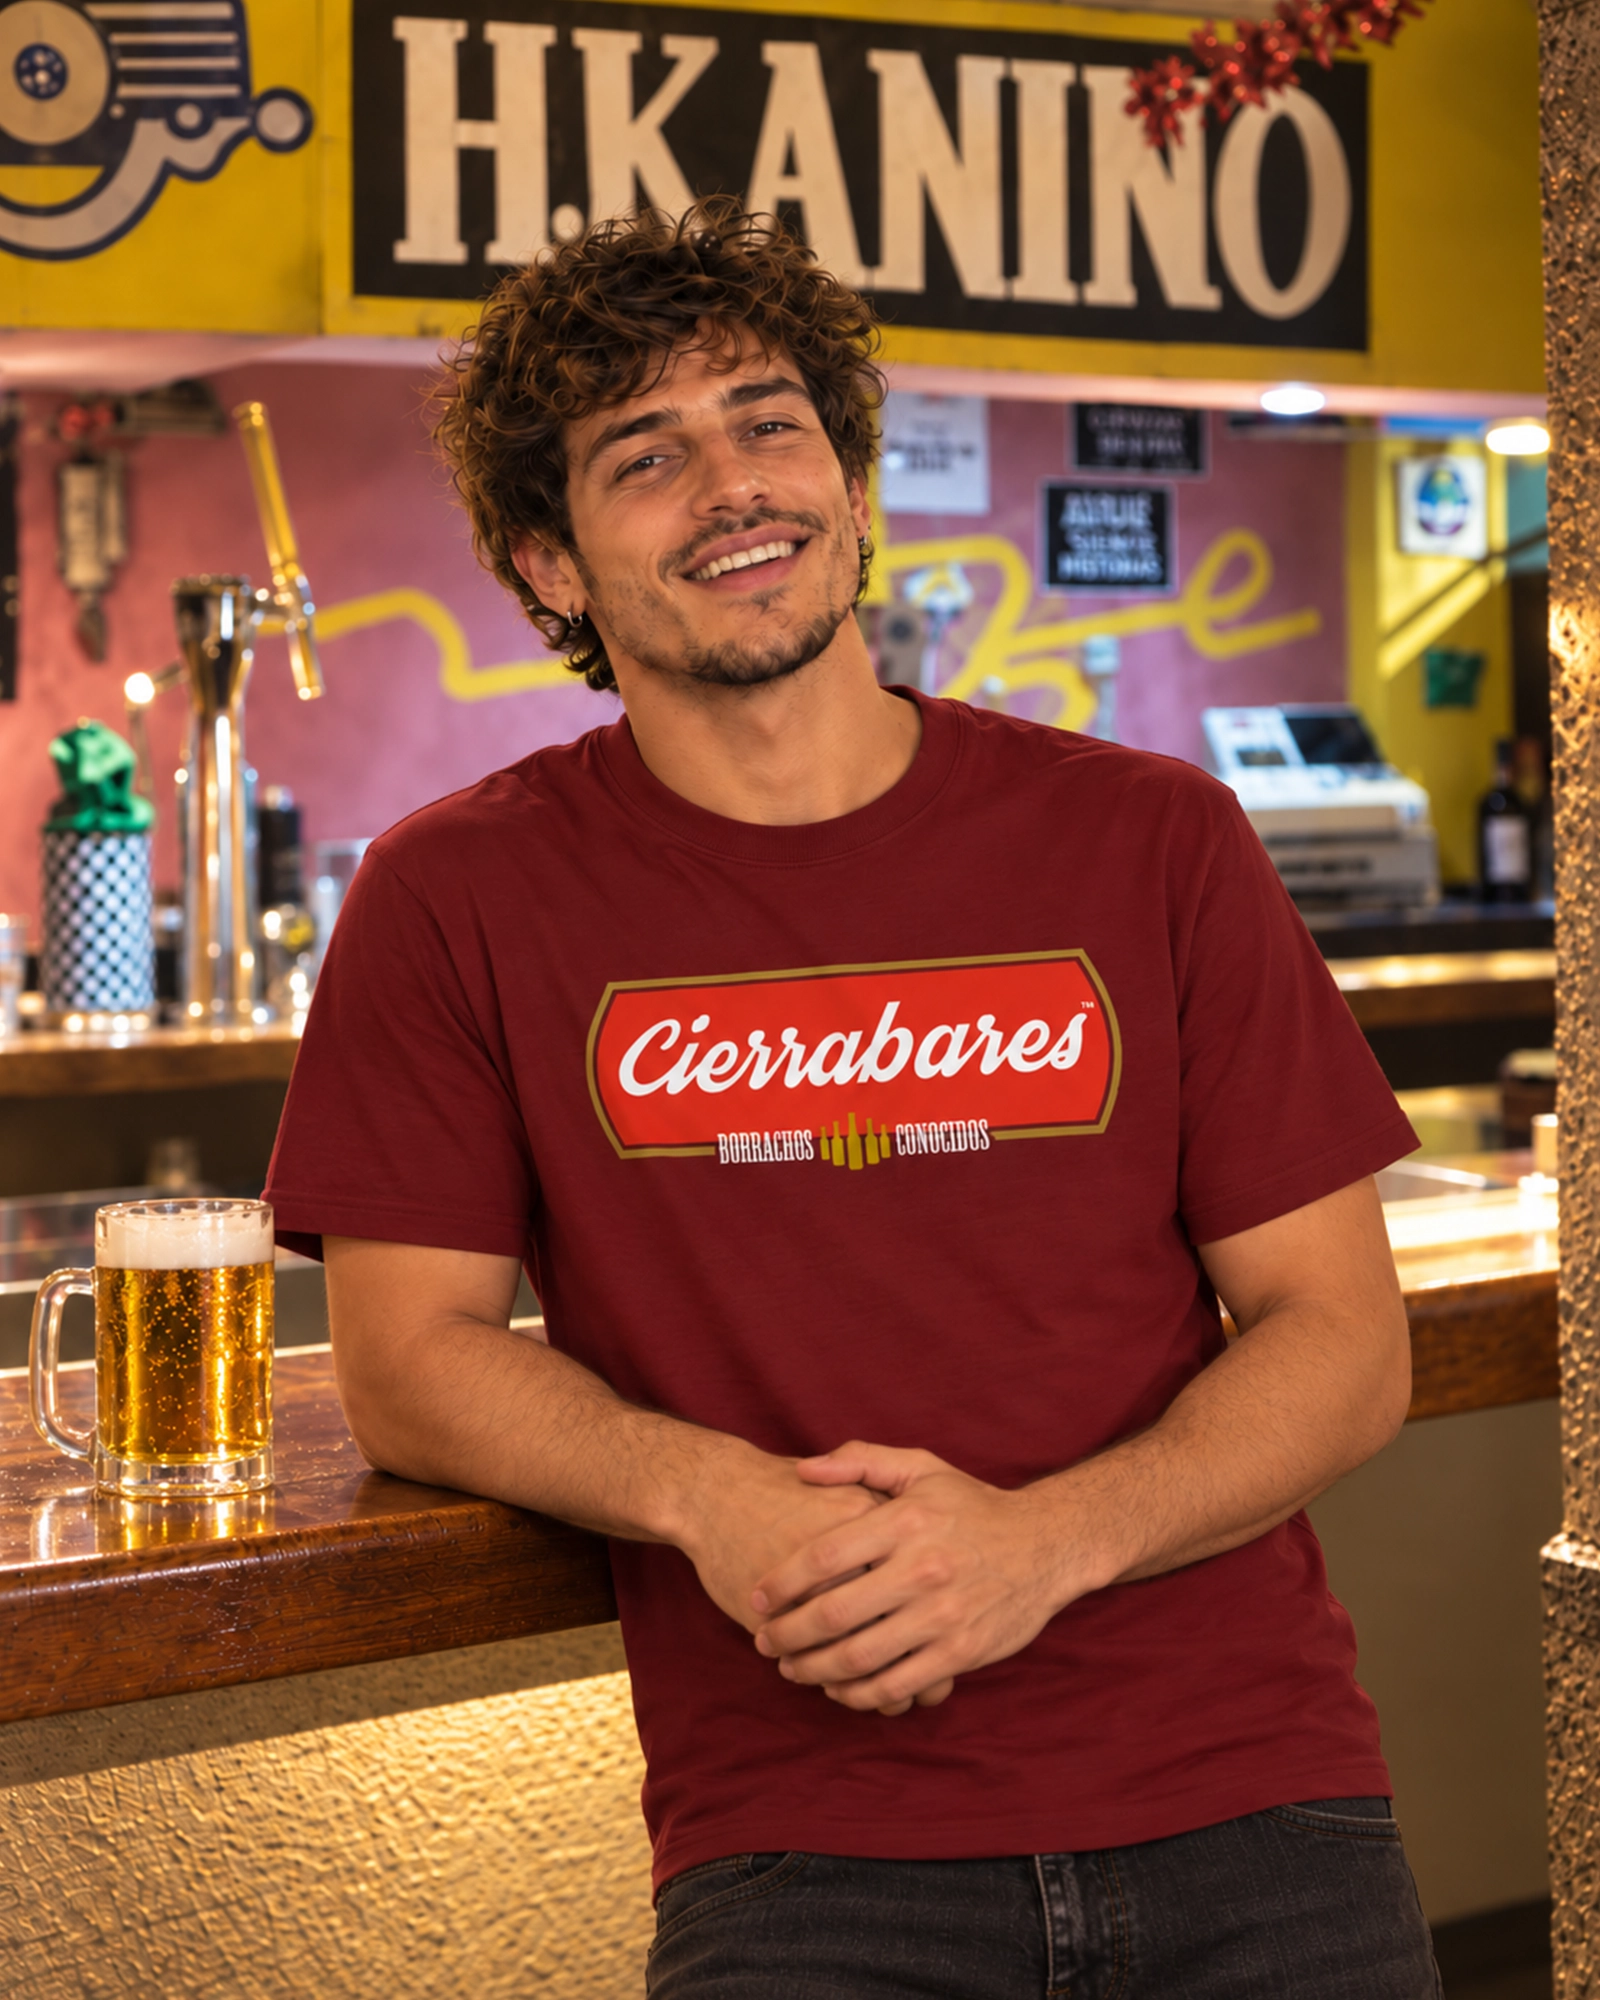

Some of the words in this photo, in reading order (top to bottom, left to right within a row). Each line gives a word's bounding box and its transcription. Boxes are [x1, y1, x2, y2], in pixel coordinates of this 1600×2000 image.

[393, 17, 1352, 320] H.KANINO
[618, 1000, 1088, 1097] Cierrabares
[717, 1129, 814, 1164] BORRACHOS
[895, 1118, 990, 1156] CONOCIDOS
